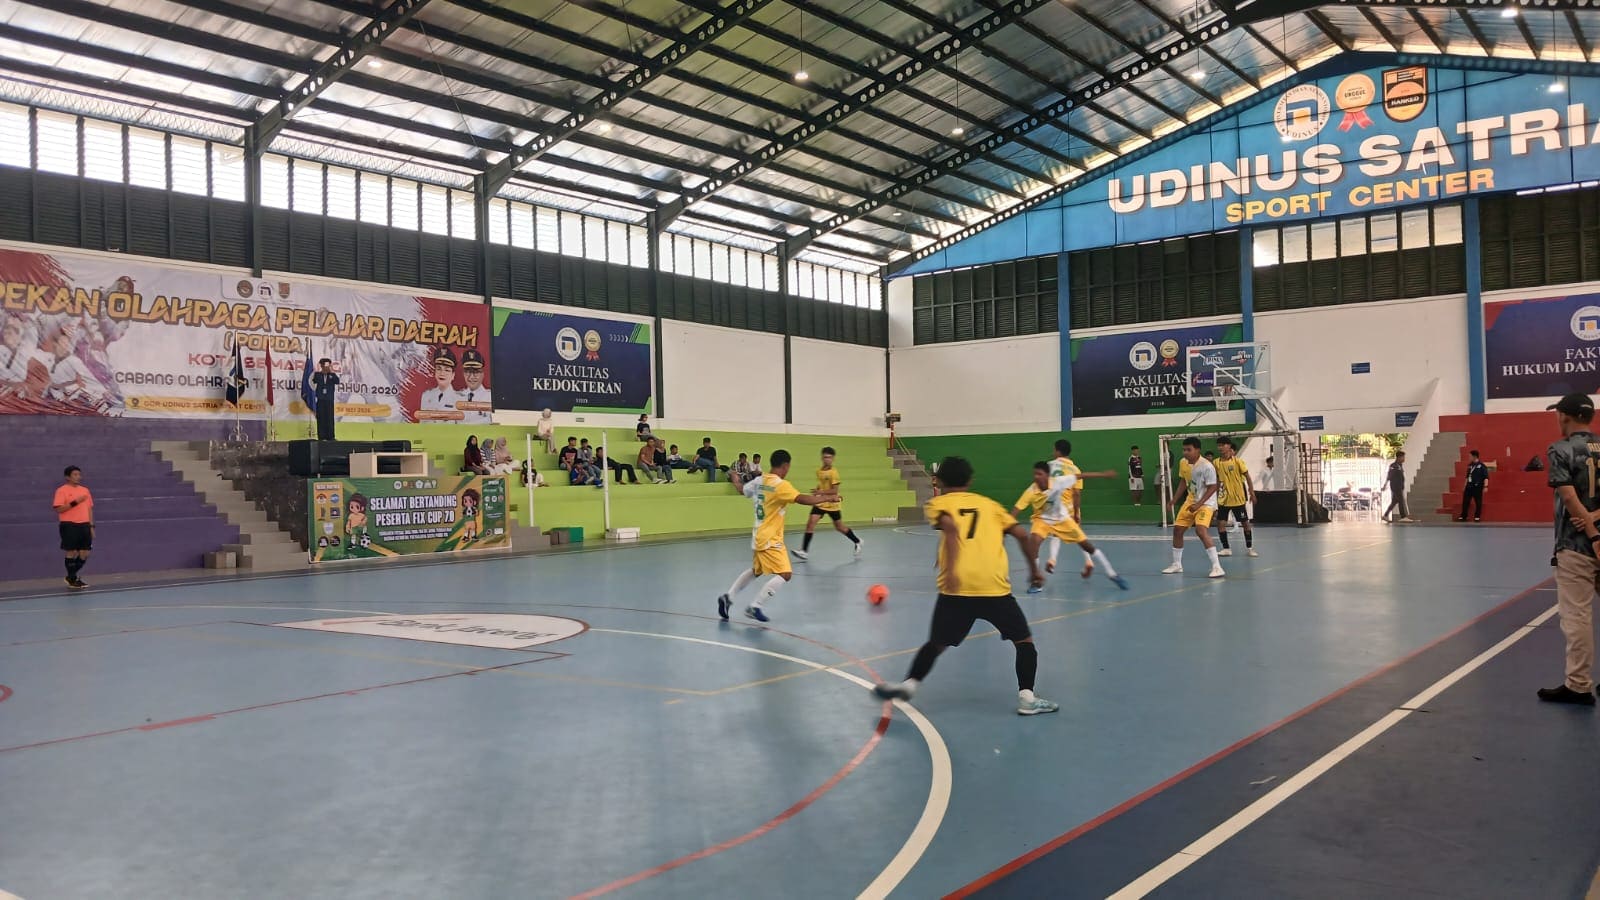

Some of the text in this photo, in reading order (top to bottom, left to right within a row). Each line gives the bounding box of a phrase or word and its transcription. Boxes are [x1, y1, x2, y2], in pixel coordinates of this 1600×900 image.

[1108, 143, 1343, 214] UDINUS
[1358, 102, 1600, 177] SATRI
[1226, 168, 1495, 223] SPORT CENTER
[0, 282, 479, 347] EKAN OLAHRAGA PELAJAR DAERAH
[1565, 346, 1600, 360] FAK
[244, 357, 342, 373] SEMARG
[548, 364, 609, 379] FAKULTAS
[1502, 361, 1596, 376] HUKUM DAN
[115, 371, 174, 386] CABANG
[178, 375, 249, 389] OLAHRA
[338, 383, 368, 394] AHUN
[371, 383, 398, 394] 2026
[533, 377, 622, 394] KEDOKTERAN
[1122, 372, 1192, 387] FAKULTAS
[1586, 456, 1600, 498] 1
[370, 494, 457, 511] SELAMAT BERTANDING
[376, 513, 410, 527] PESERTA
[412, 512, 426, 525] FIX
[427, 510, 442, 524] CUP
[958, 508, 979, 539] 7
